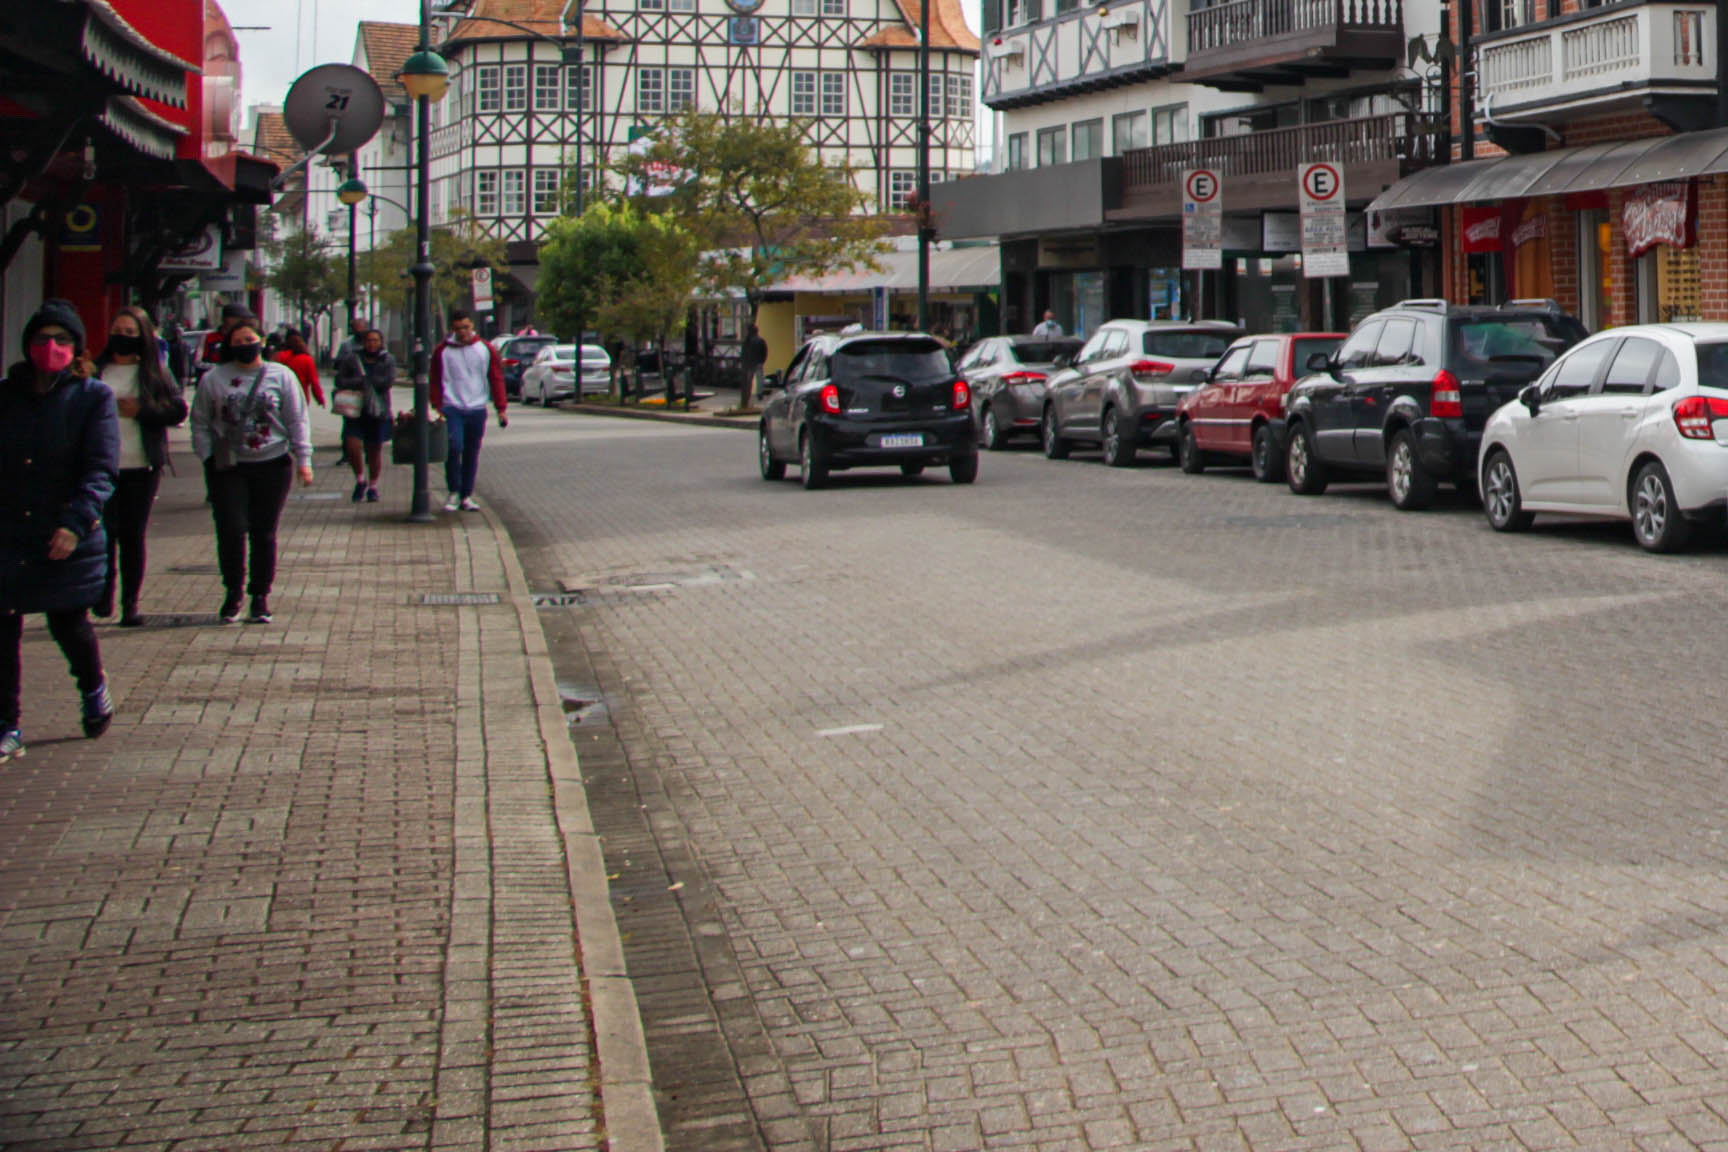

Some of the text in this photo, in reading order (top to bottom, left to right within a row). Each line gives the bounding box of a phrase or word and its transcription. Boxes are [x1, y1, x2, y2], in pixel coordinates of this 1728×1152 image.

[325, 94, 350, 110] 21
[1196, 177, 1208, 196] E
[1314, 172, 1328, 194] E
